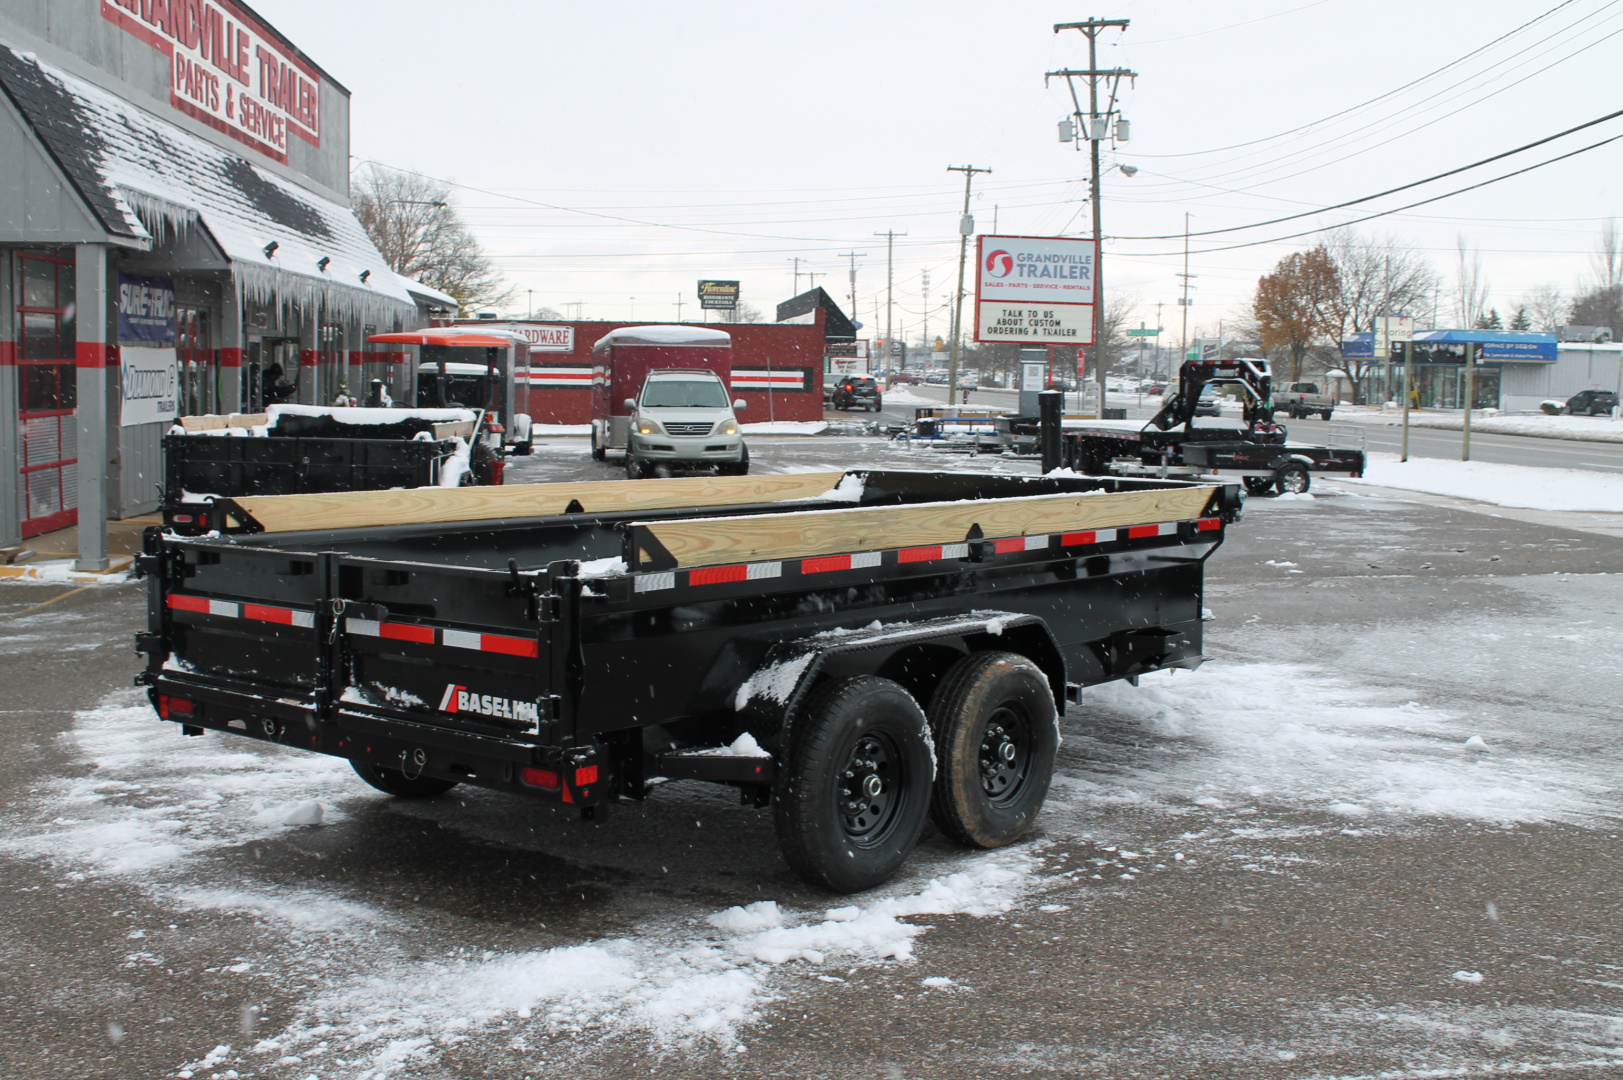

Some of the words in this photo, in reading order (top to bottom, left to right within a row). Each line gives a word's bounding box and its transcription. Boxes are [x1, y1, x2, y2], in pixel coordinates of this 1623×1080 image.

[111, 0, 250, 88] ANDVILLE
[256, 44, 318, 132] TRAILER
[176, 52, 220, 112] PARTS
[226, 83, 235, 120] &
[239, 93, 285, 149] SERVICE
[1016, 253, 1092, 265] GRANDVILLE
[1016, 264, 1090, 280] TRAILER
[1002, 310, 1023, 318] TALK
[1028, 310, 1038, 318] TO
[1044, 311, 1054, 319] US
[997, 318, 1023, 326] ABOUT
[1029, 319, 1062, 327] CUSTOM
[508, 329, 570, 344] RDWARE
[987, 327, 1029, 335] ORDERING
[1043, 328, 1077, 336] TRAILER
[127, 365, 167, 400] DIAMOND
[167, 364, 175, 397] C
